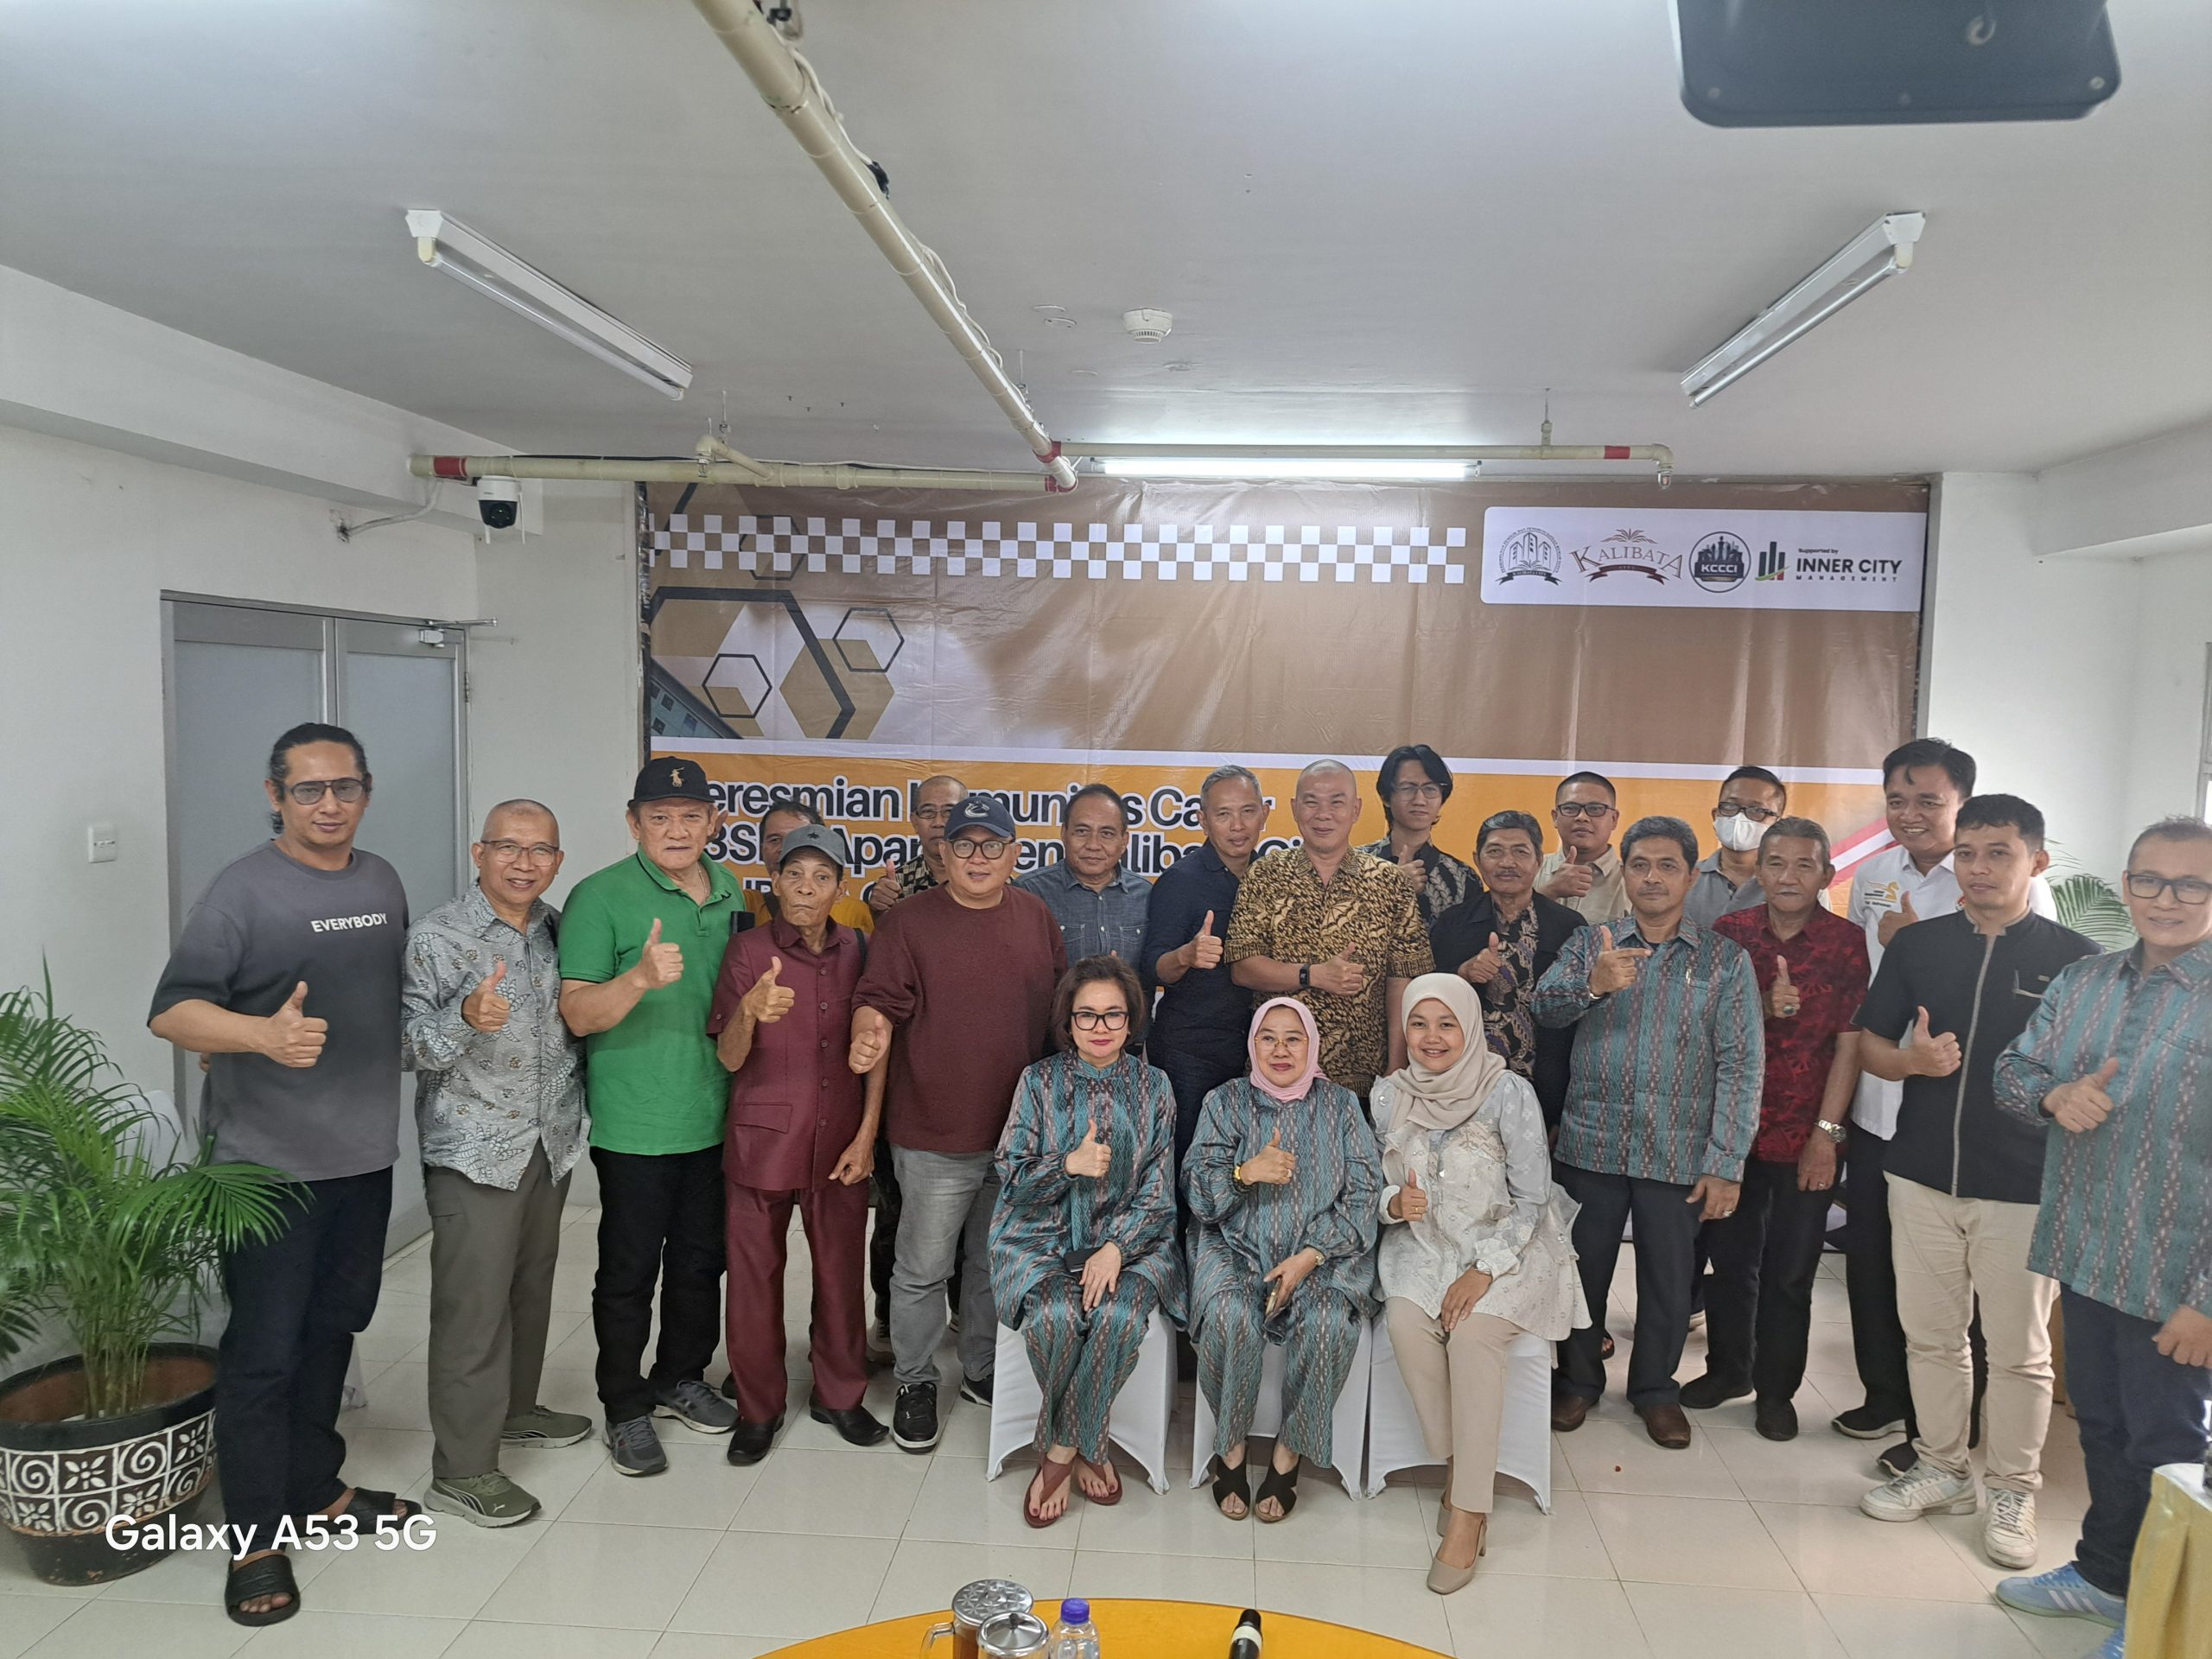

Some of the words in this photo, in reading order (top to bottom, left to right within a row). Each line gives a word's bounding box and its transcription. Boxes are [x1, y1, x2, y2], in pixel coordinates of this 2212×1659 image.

[1569, 545, 1682, 580] KALIBATA
[1700, 563, 1738, 574] KCCCI
[1796, 557, 1854, 573] INNER
[1858, 558, 1903, 575] CITY
[707, 778, 900, 820] eresmian
[310, 912, 388, 932] EVERYBODY
